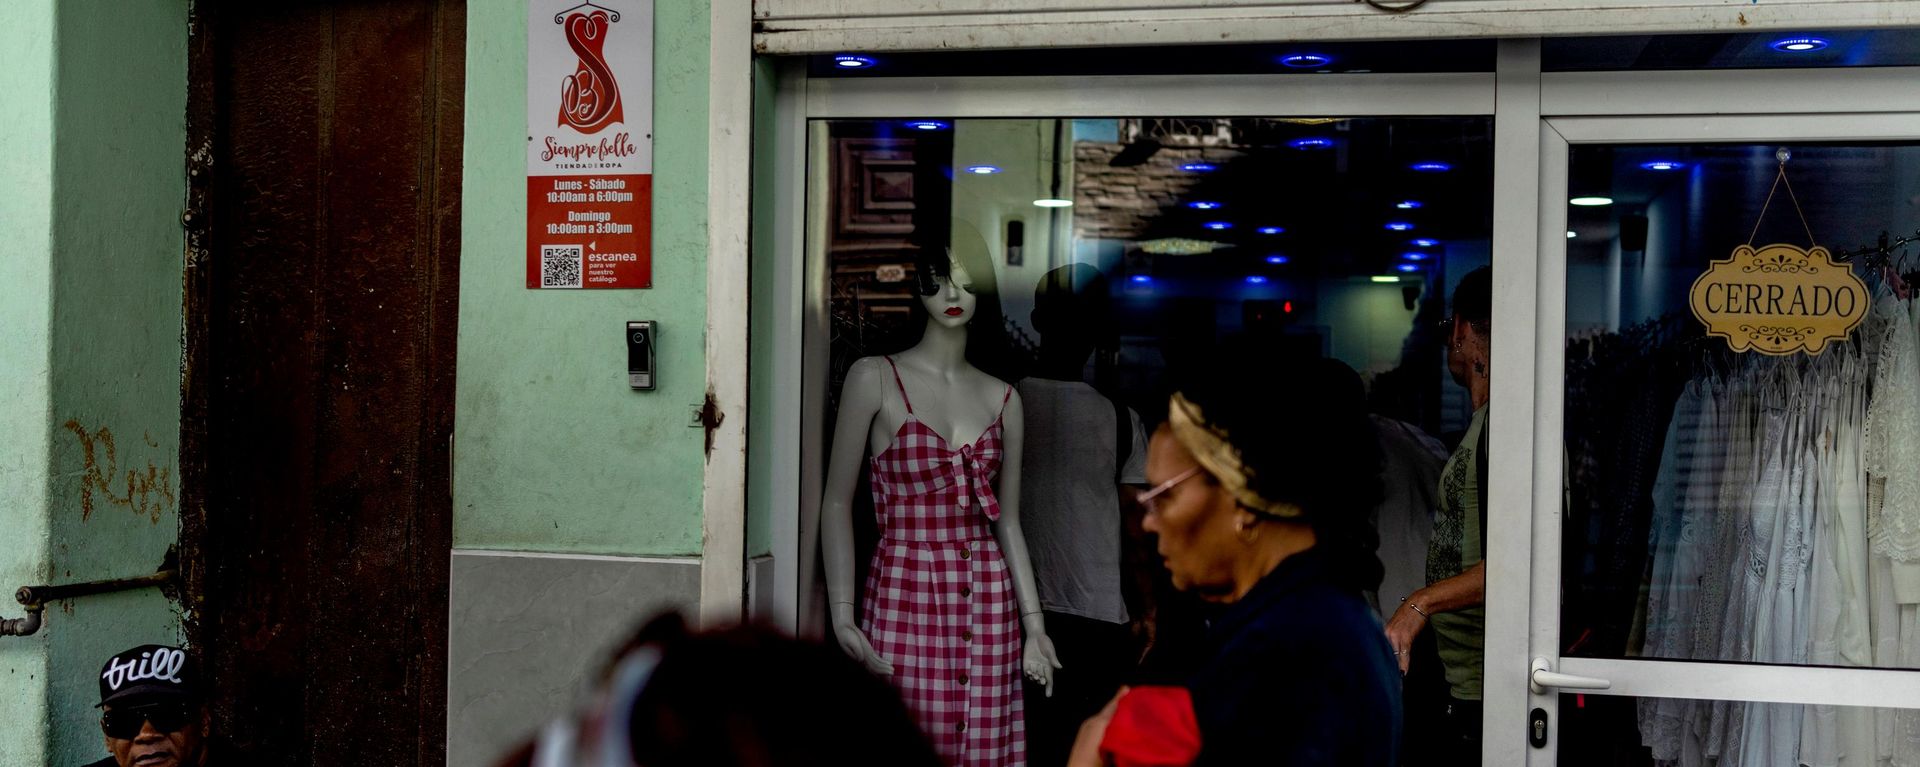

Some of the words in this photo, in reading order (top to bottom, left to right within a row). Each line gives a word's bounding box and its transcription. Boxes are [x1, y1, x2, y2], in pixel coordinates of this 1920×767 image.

[554, 179, 582, 190] Lunes
[589, 178, 626, 190] Sábado
[546, 191, 587, 203] 10:00am
[588, 192, 595, 202] a
[596, 191, 633, 202] 6:00pm
[568, 210, 611, 222] Domingo
[546, 223, 587, 234] 10:00am
[588, 224, 595, 233] a
[596, 222, 633, 234] 3:00pm
[588, 253, 637, 261] escanea
[1705, 282, 1855, 318] CERRADO
